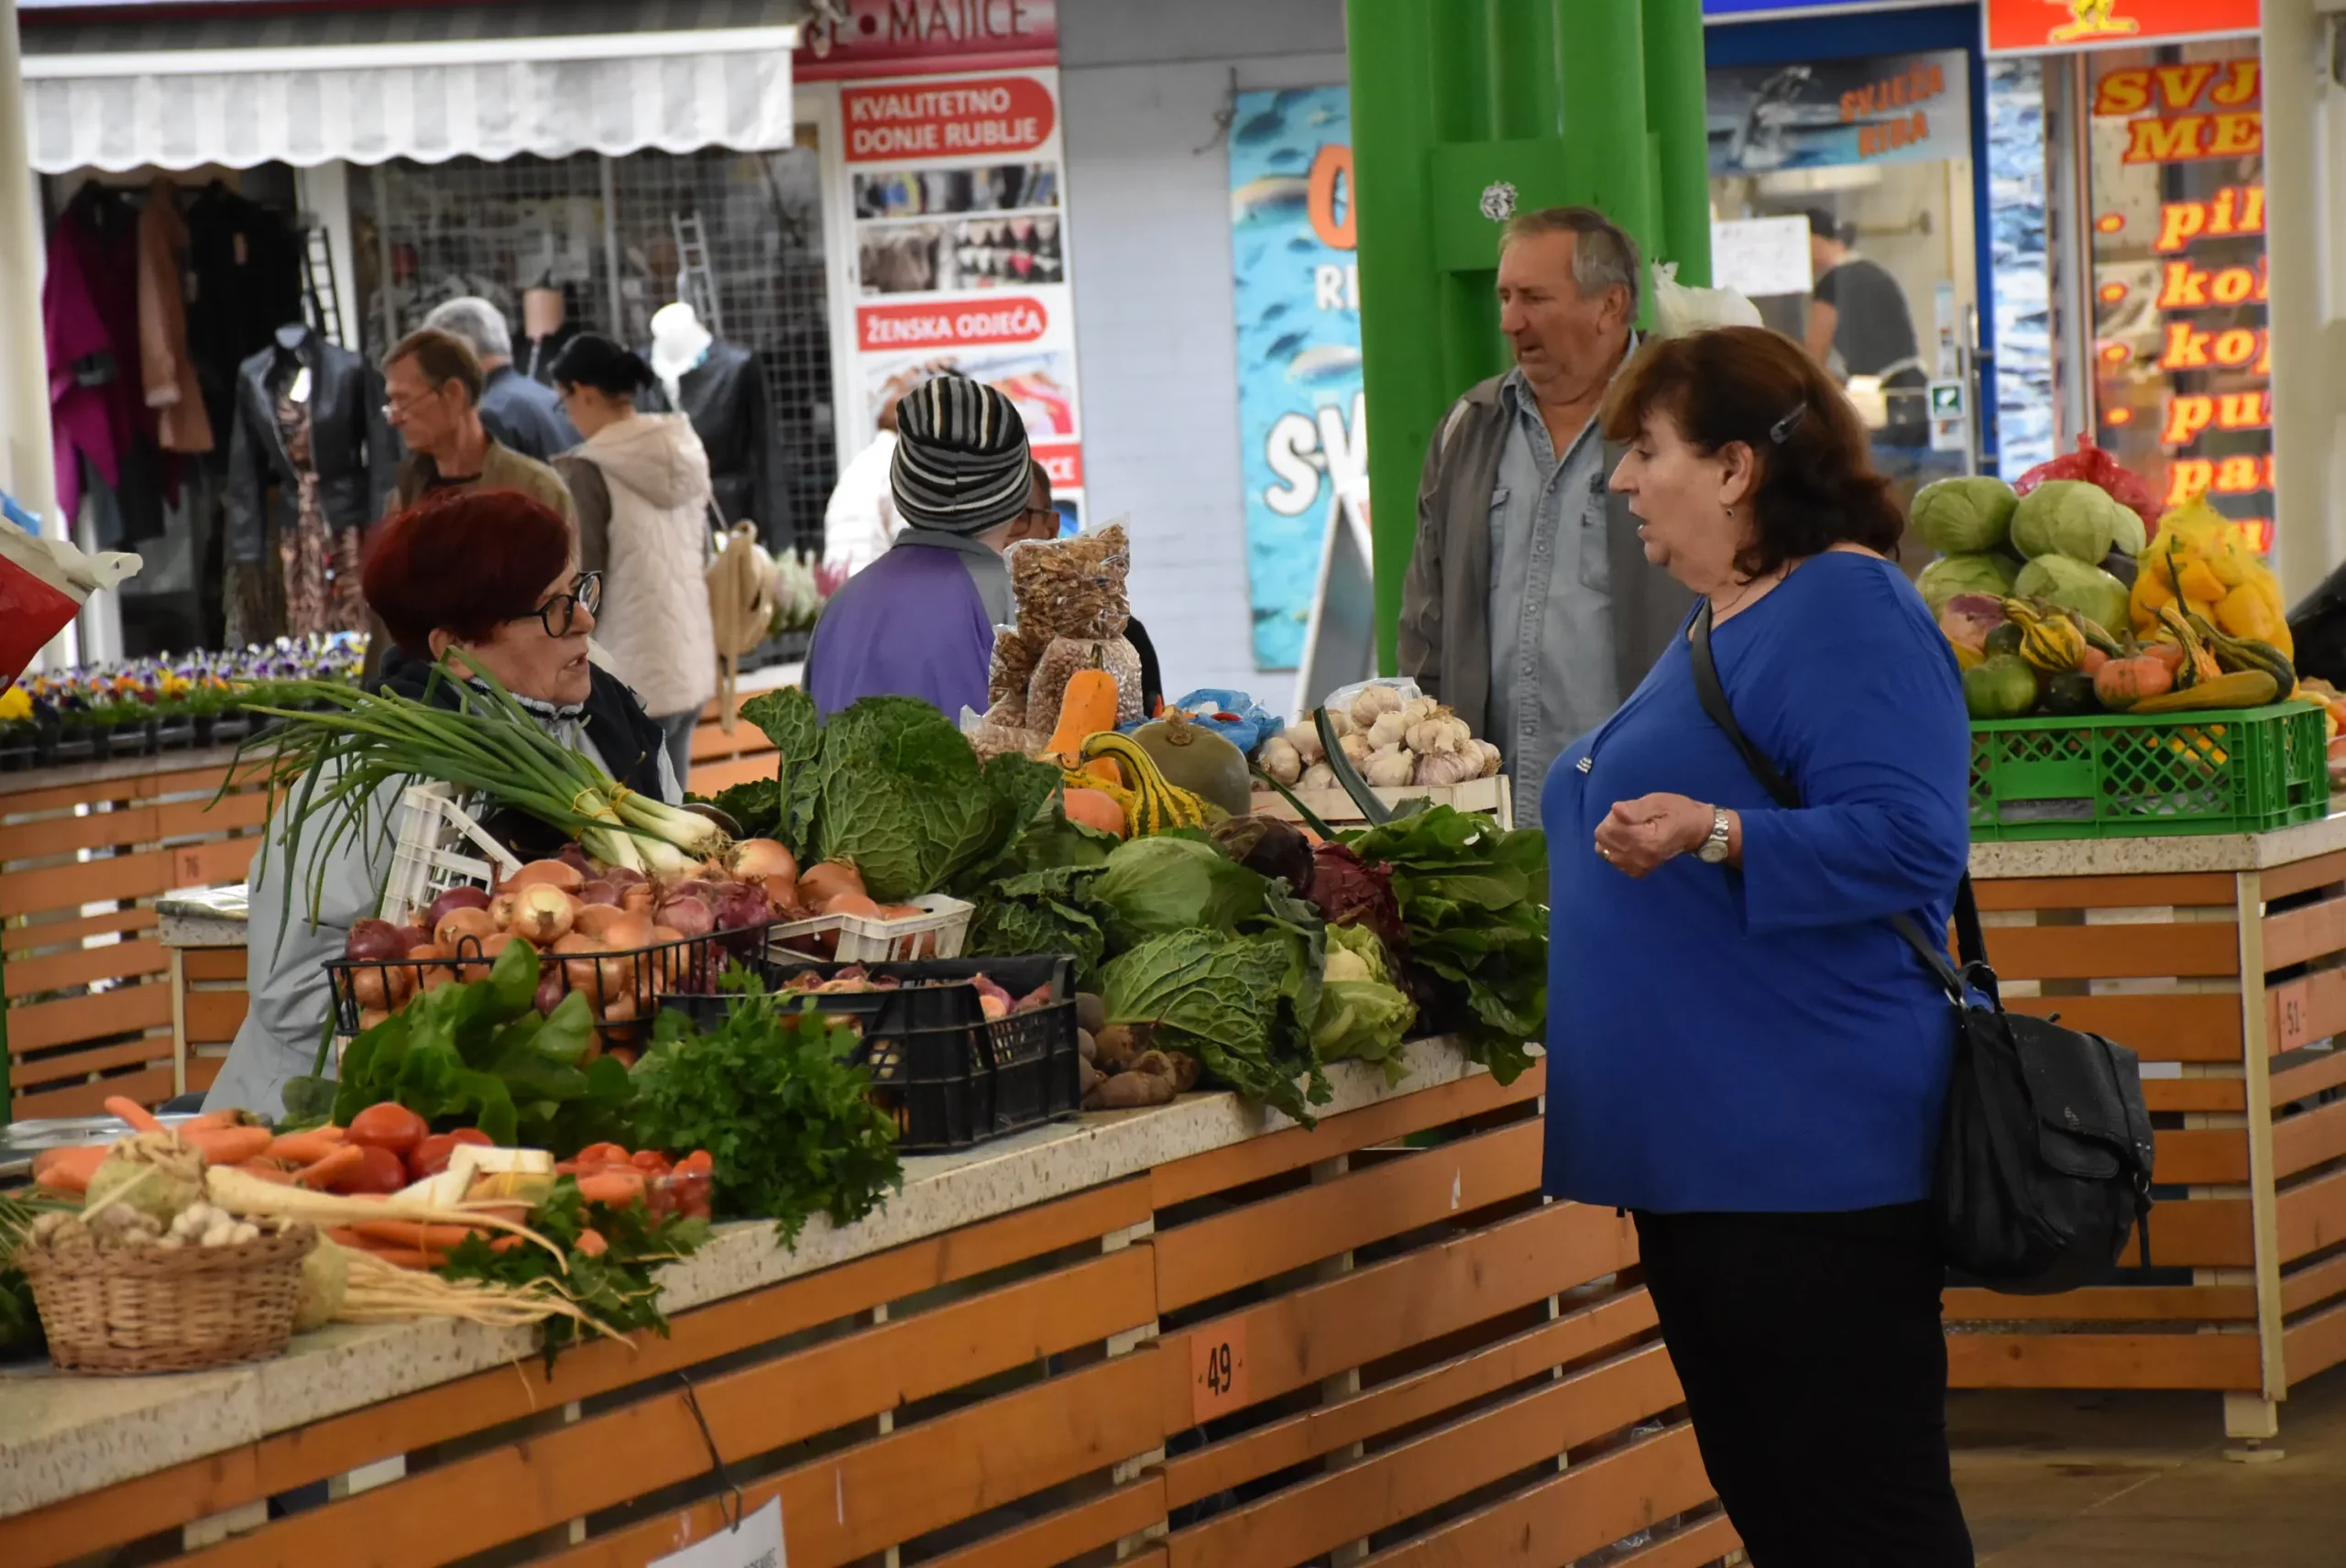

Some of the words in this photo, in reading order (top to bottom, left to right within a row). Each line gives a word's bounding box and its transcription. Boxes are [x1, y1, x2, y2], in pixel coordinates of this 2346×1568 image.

[850, 87, 1011, 121] KVALITETNO
[2094, 58, 2262, 115] SVJ
[853, 125, 938, 154] DONJE
[944, 117, 1038, 148] RUBLJE
[2121, 111, 2263, 165] ME
[867, 314, 953, 343] ŽENSKA
[956, 305, 1042, 338] ODJEĆA
[2161, 391, 2273, 444] pu
[2286, 1000, 2301, 1036] 51
[1208, 1343, 1232, 1397] 49
